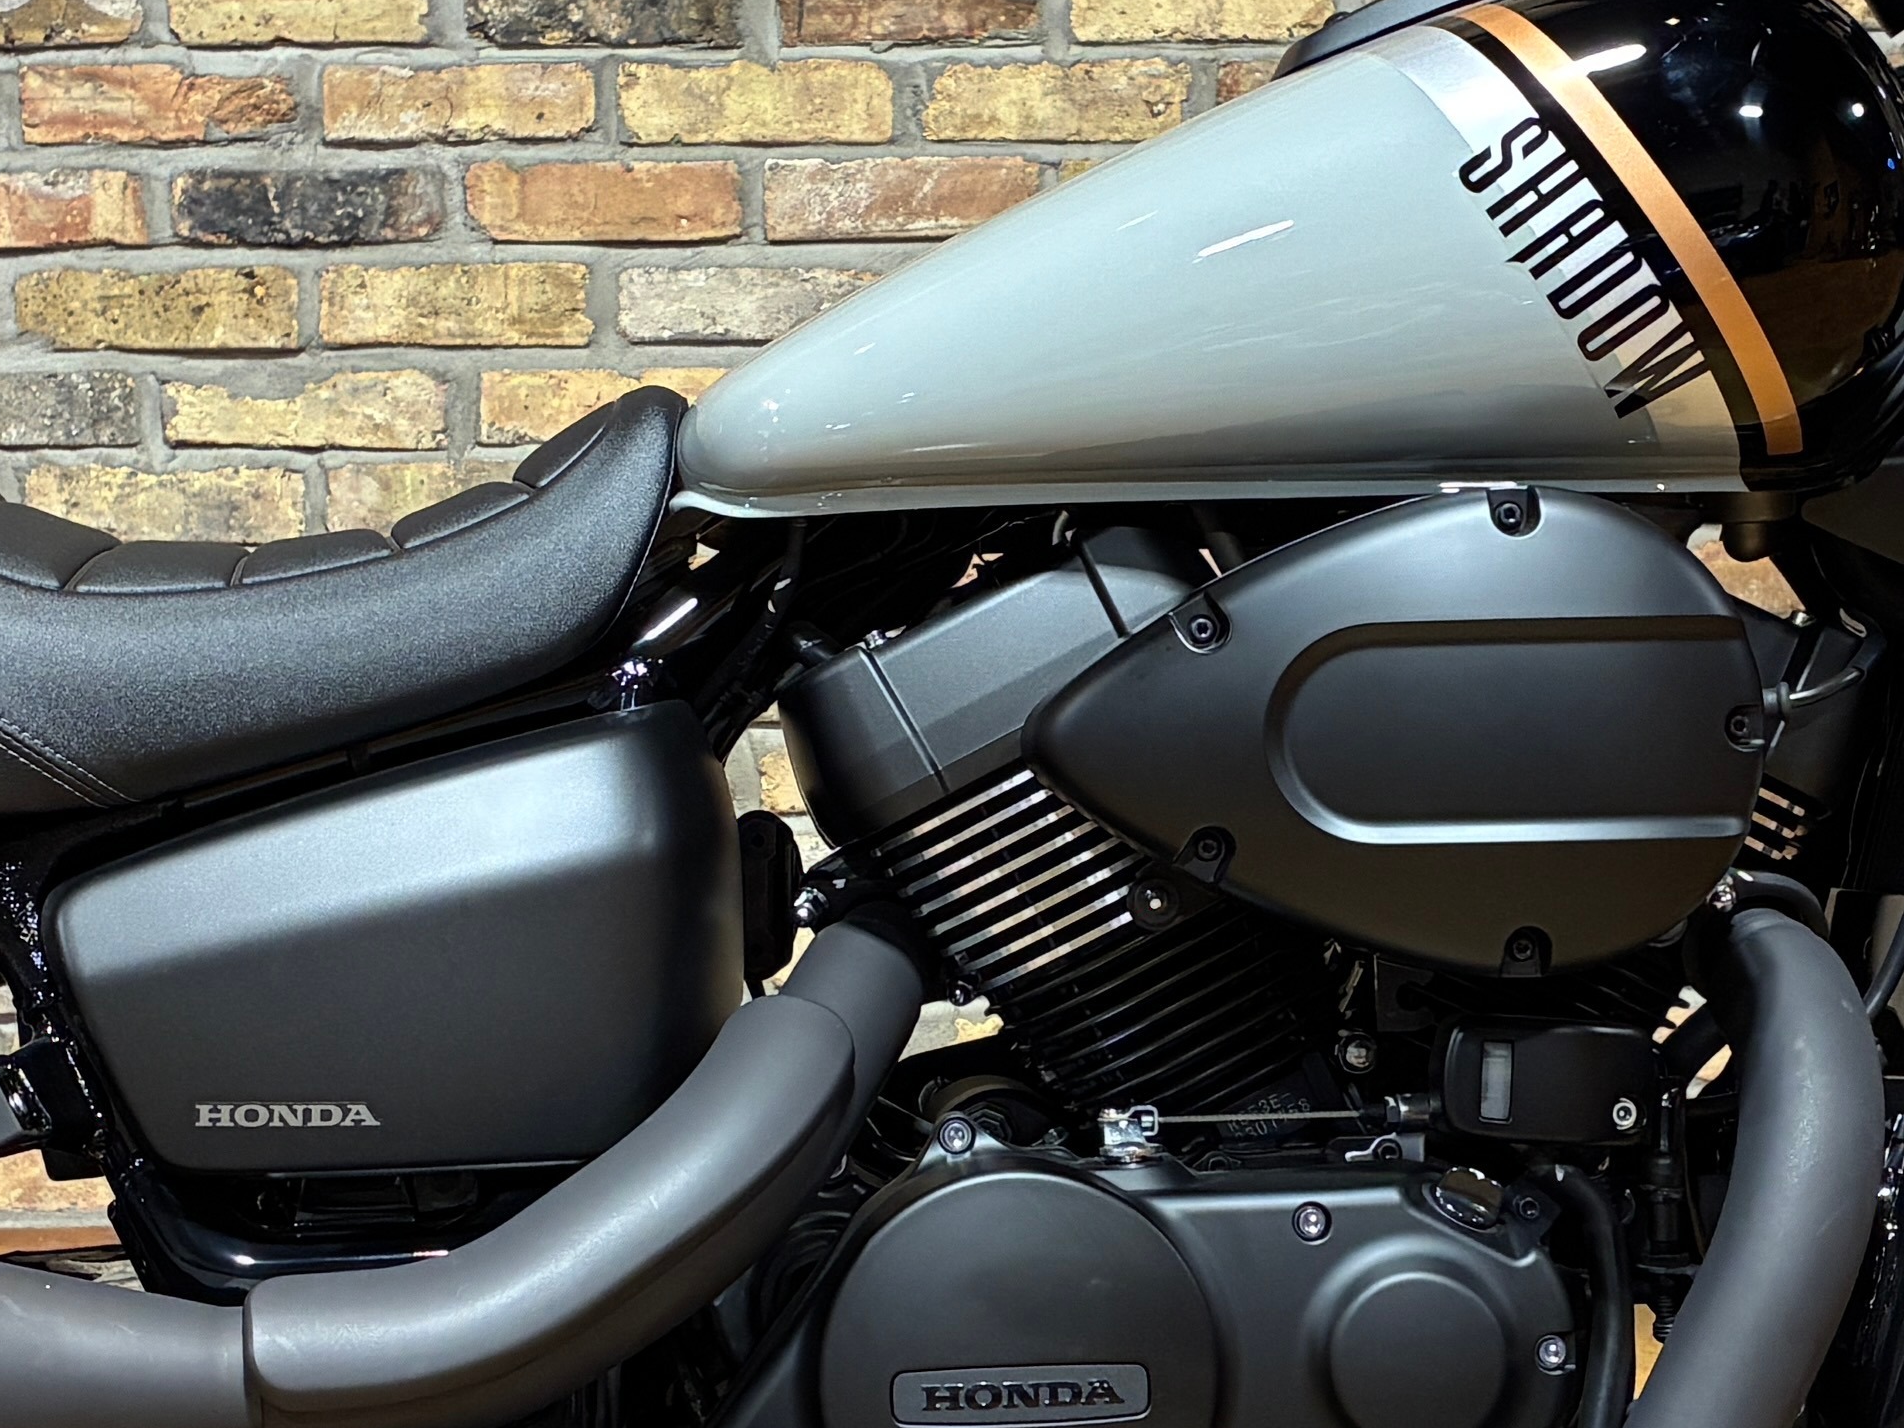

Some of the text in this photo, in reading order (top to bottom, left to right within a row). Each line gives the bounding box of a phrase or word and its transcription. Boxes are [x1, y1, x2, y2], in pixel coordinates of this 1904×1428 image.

[1458, 116, 1710, 419] SHADOW
[194, 1103, 380, 1128] HONDA
[920, 1379, 1125, 1413] HONDA
